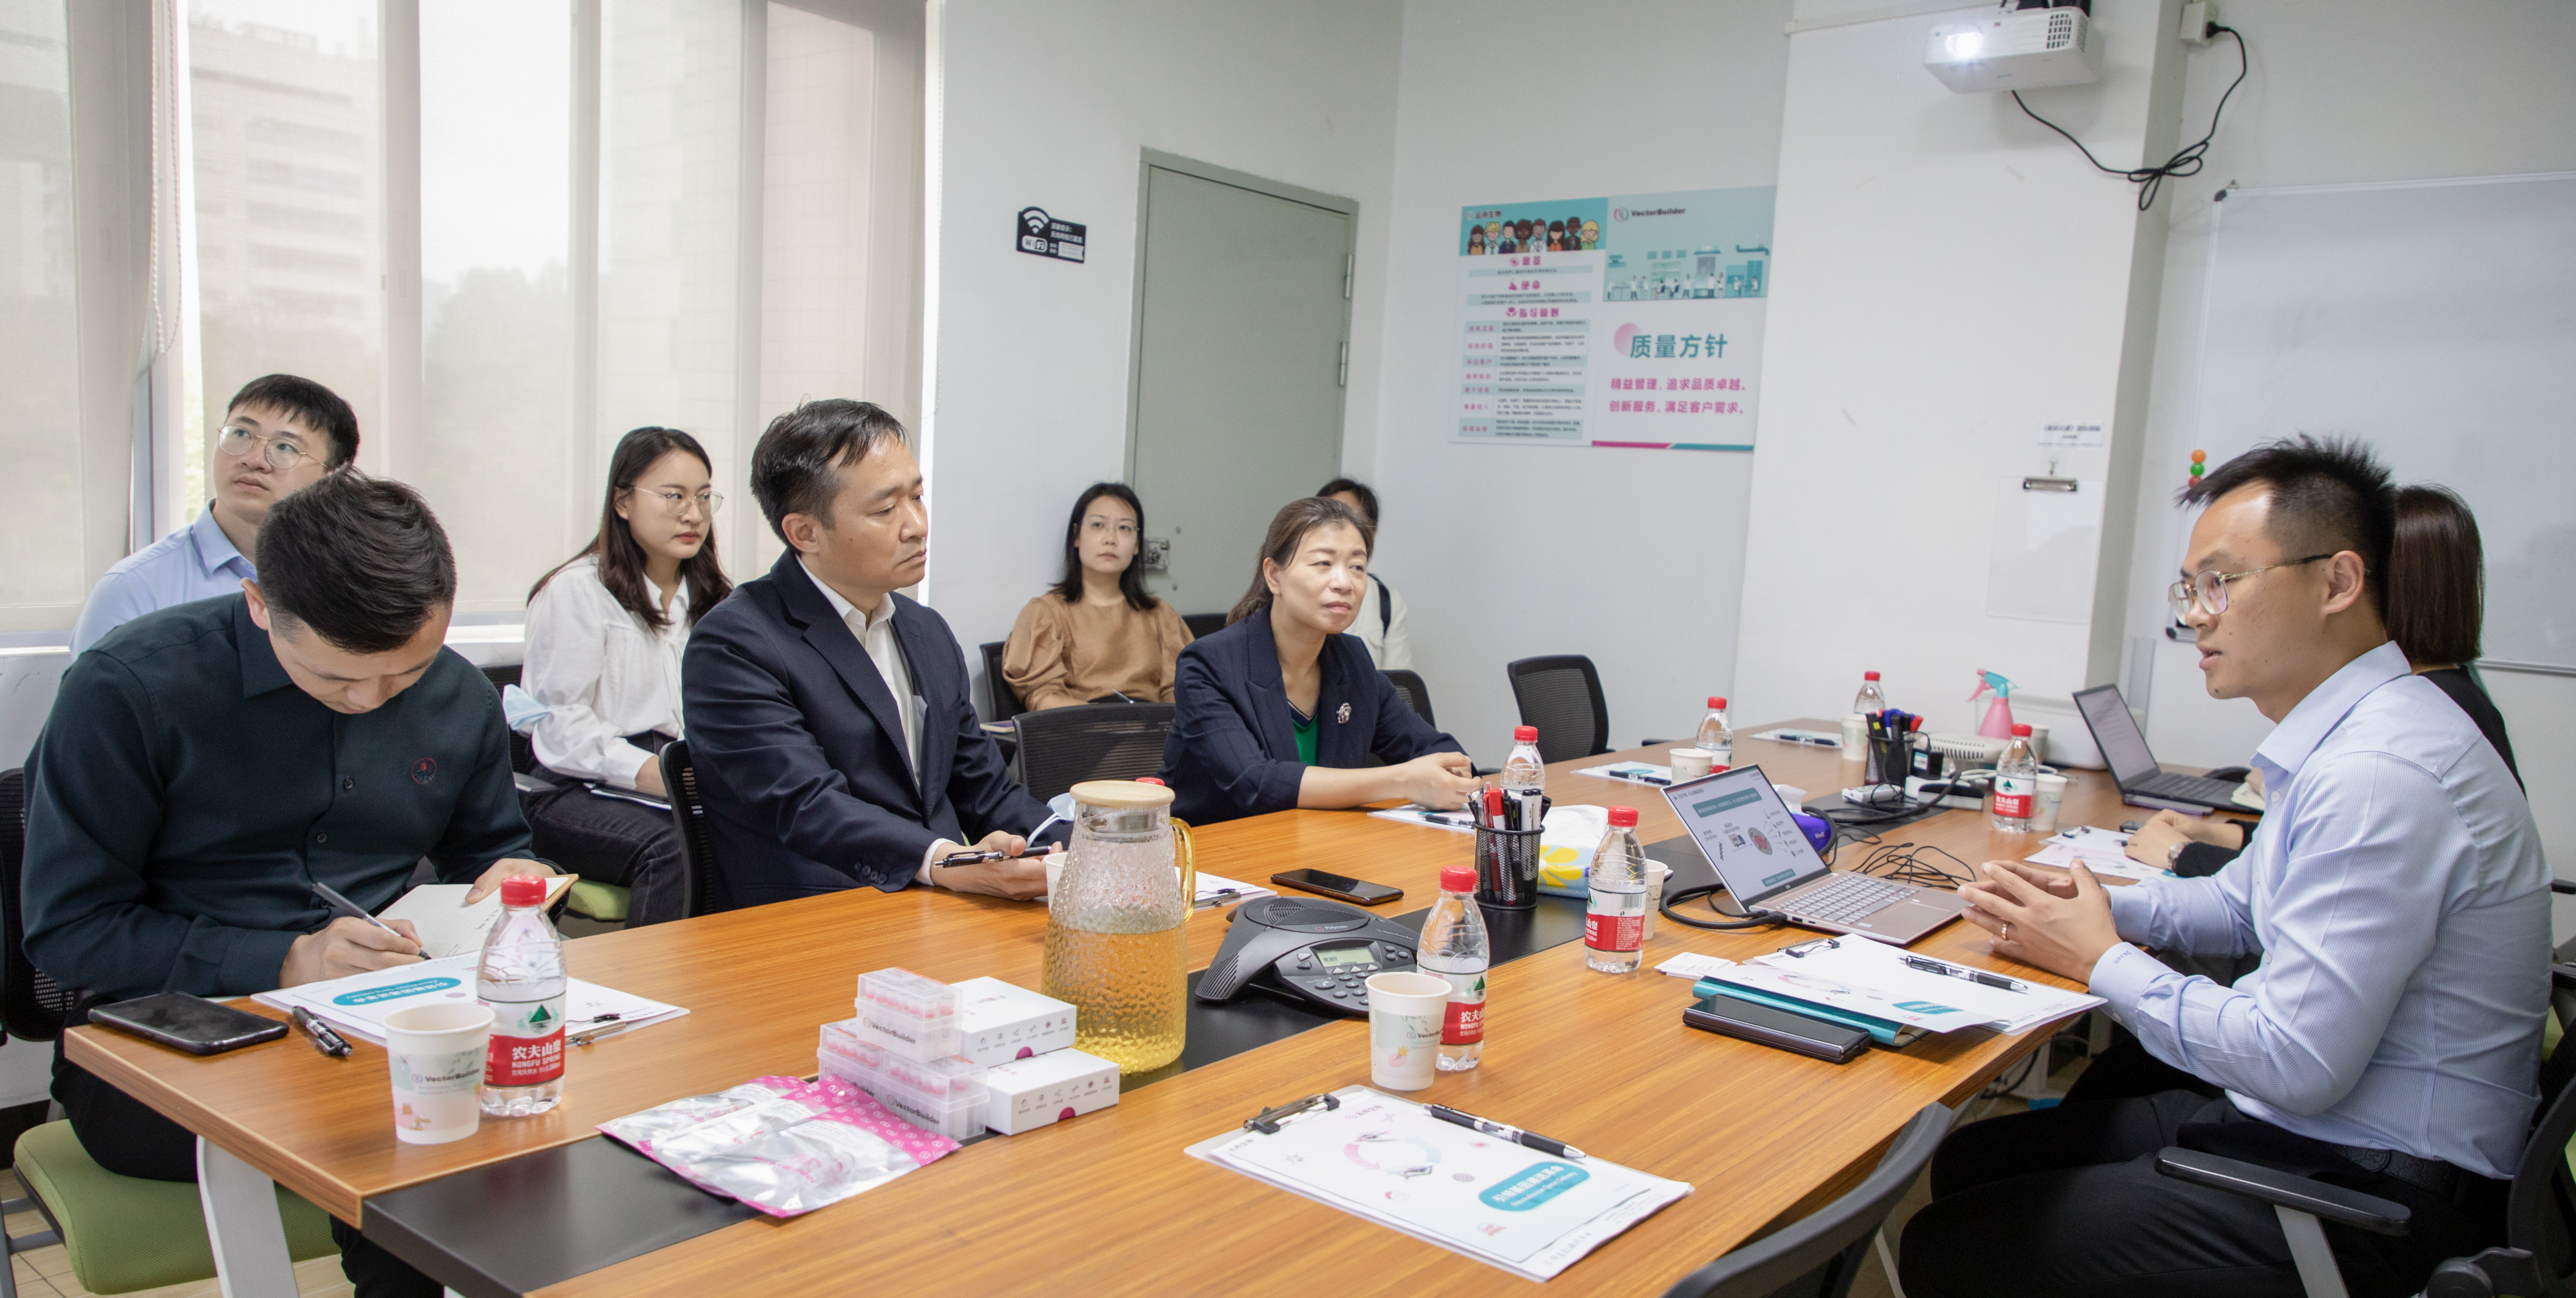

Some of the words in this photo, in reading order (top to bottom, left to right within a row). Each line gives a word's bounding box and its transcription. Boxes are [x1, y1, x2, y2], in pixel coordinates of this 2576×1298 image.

[1630, 333, 1728, 358] 质量方针
[871, 1021, 916, 1044] VectorBuilder
[512, 1039, 561, 1060] 农夫山泉
[512, 1059, 540, 1068] NONGFU
[542, 1053, 561, 1065] SPRING
[425, 1067, 480, 1081] VectorBuilder
[895, 1099, 940, 1125] VectorBuilder
[1357, 1105, 1384, 1116] 云舟生物
[1542, 1180, 1559, 1189] Gene
[1555, 1171, 1578, 1181] Delivery
